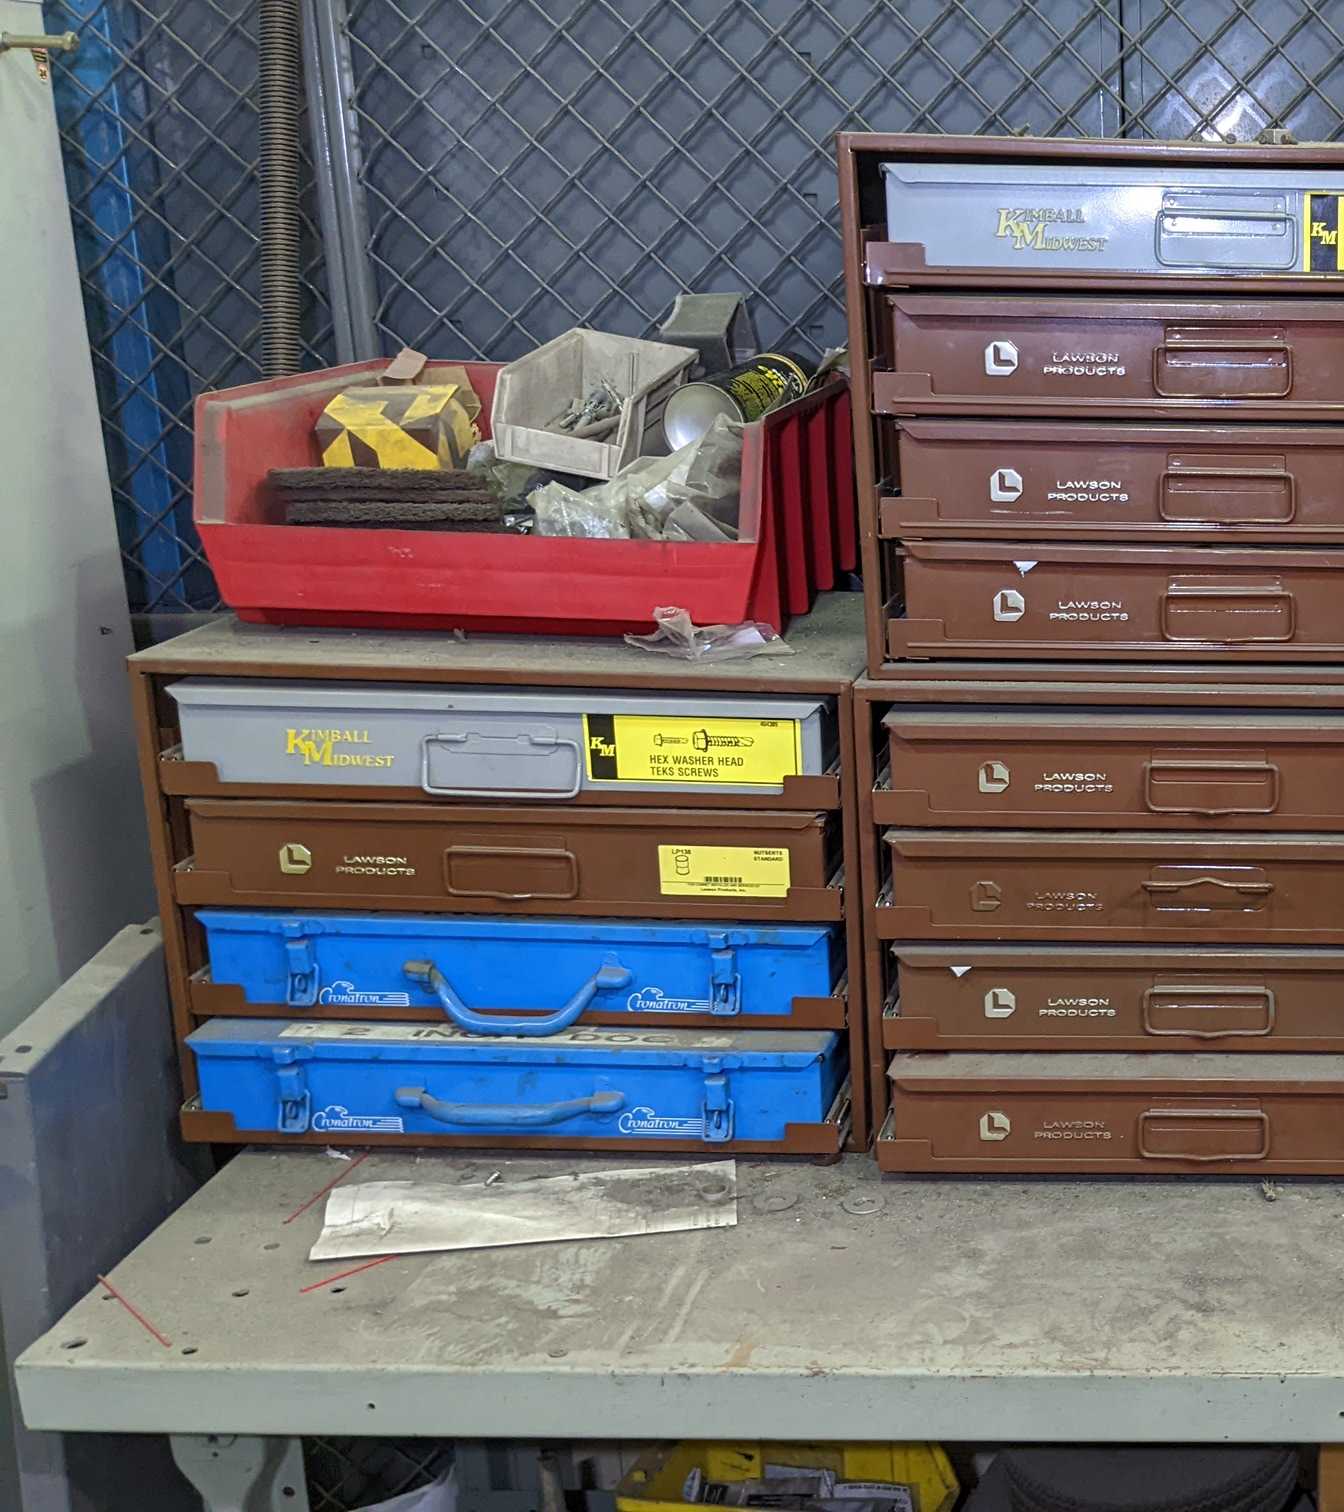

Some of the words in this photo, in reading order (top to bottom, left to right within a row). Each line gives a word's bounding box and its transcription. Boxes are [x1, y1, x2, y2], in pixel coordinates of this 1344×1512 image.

[995, 207, 1086, 238] KIMBALL
[1012, 222, 1109, 251] MIDWEST
[1052, 352, 1119, 363] LAWSON
[1043, 366, 1126, 376] PRODUCTS
[1056, 480, 1122, 489] LAWSON
[1047, 493, 1129, 501] PRODUCTS
[1058, 601, 1122, 610] LAWSON
[1049, 613, 1129, 621] PRODUCTS
[286, 728, 373, 754] KIMBALL
[300, 740, 395, 767] MIDWEST
[650, 755, 669, 765] HEX
[672, 755, 714, 766] WASHER
[717, 756, 744, 766] HEAD
[650, 766, 675, 777] TEKS
[678, 767, 719, 777] SCREWS
[1043, 773, 1107, 781] LAWSON
[1034, 784, 1113, 792] PRODUCTS
[343, 856, 408, 865] LAWSON
[335, 866, 417, 876] PRODUCTS
[1047, 998, 1110, 1006] LAWSON
[1038, 1009, 1117, 1017] PRODUCTS
[1042, 1120, 1105, 1129] LAWSON
[1034, 1131, 1113, 1140] PRODUCTS
